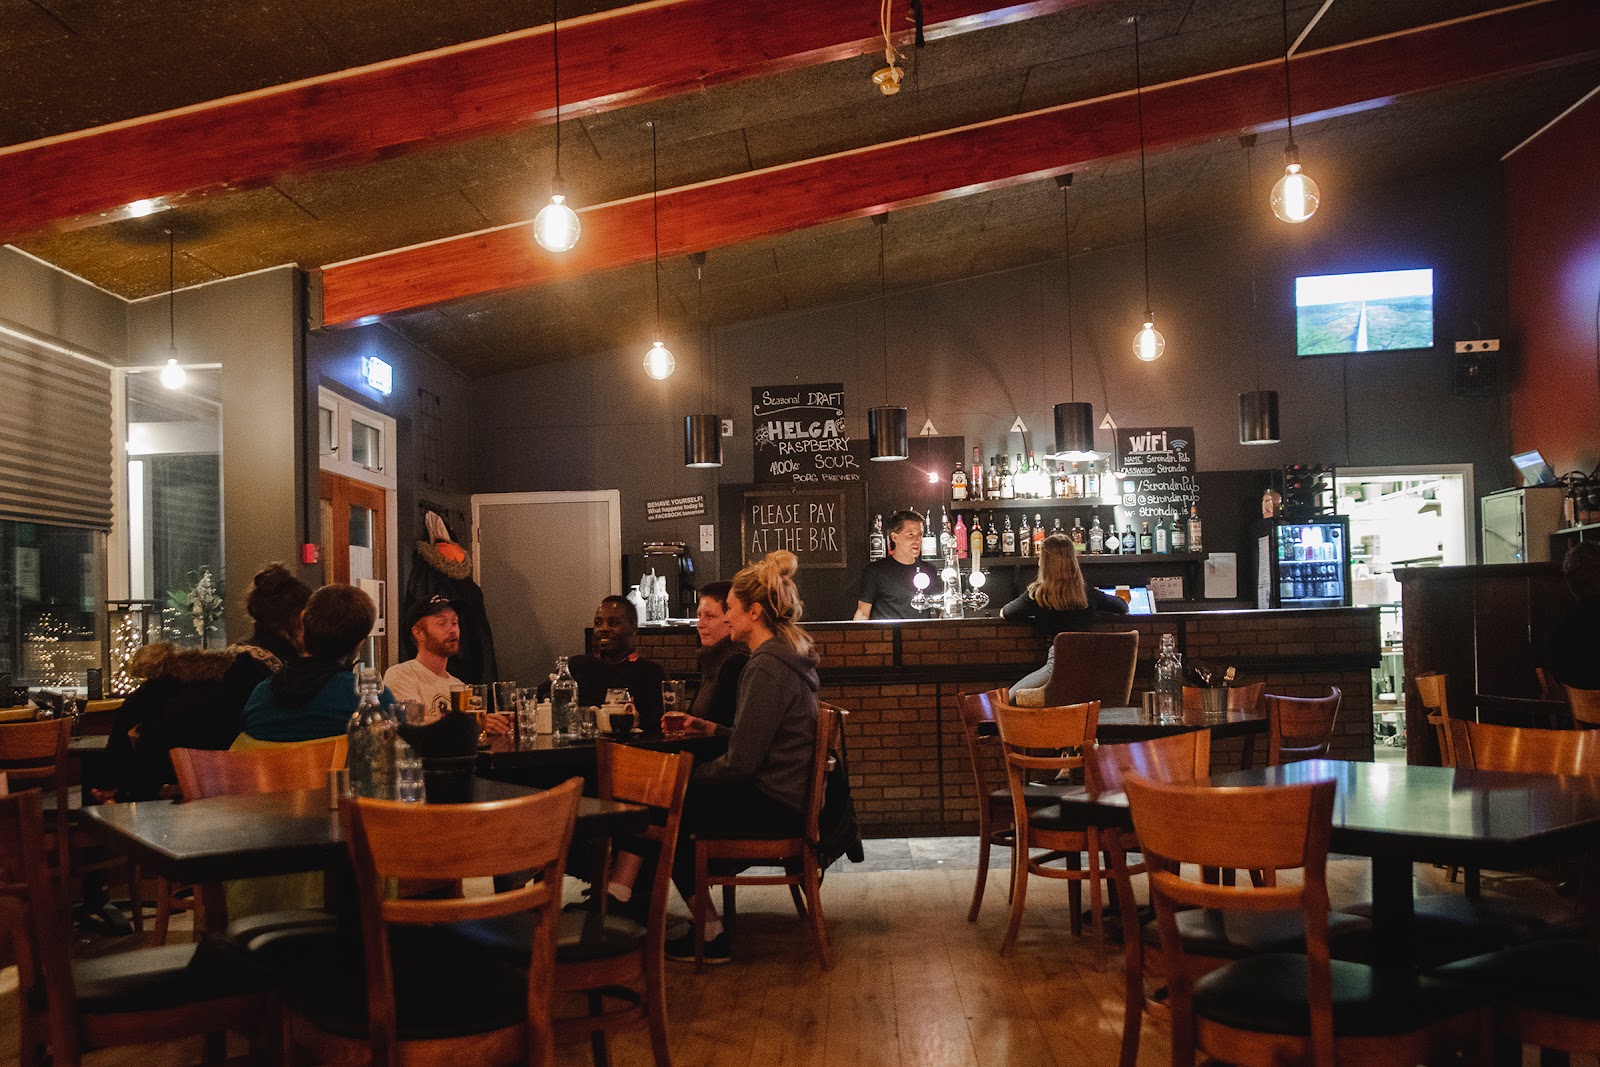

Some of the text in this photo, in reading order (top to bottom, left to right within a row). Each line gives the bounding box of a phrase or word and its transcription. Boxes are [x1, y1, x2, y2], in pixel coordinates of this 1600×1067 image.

[762, 390, 845, 406] Seasonal DRAFT
[767, 420, 839, 440] HELGA
[778, 436, 850, 455] RASPBERRY
[814, 453, 860, 469] SOUR
[1178, 452, 1190, 462] Pub
[1157, 463, 1187, 474] Strondin
[792, 473, 860, 483] BORG BREWERY
[647, 496, 703, 508] BEHAVE YOURSELF!
[655, 511, 682, 519] FACEBOOK
[752, 502, 835, 525] PLEASE PAY
[752, 528, 769, 552] AT
[774, 527, 804, 552] THE
[809, 526, 838, 552] BAR
